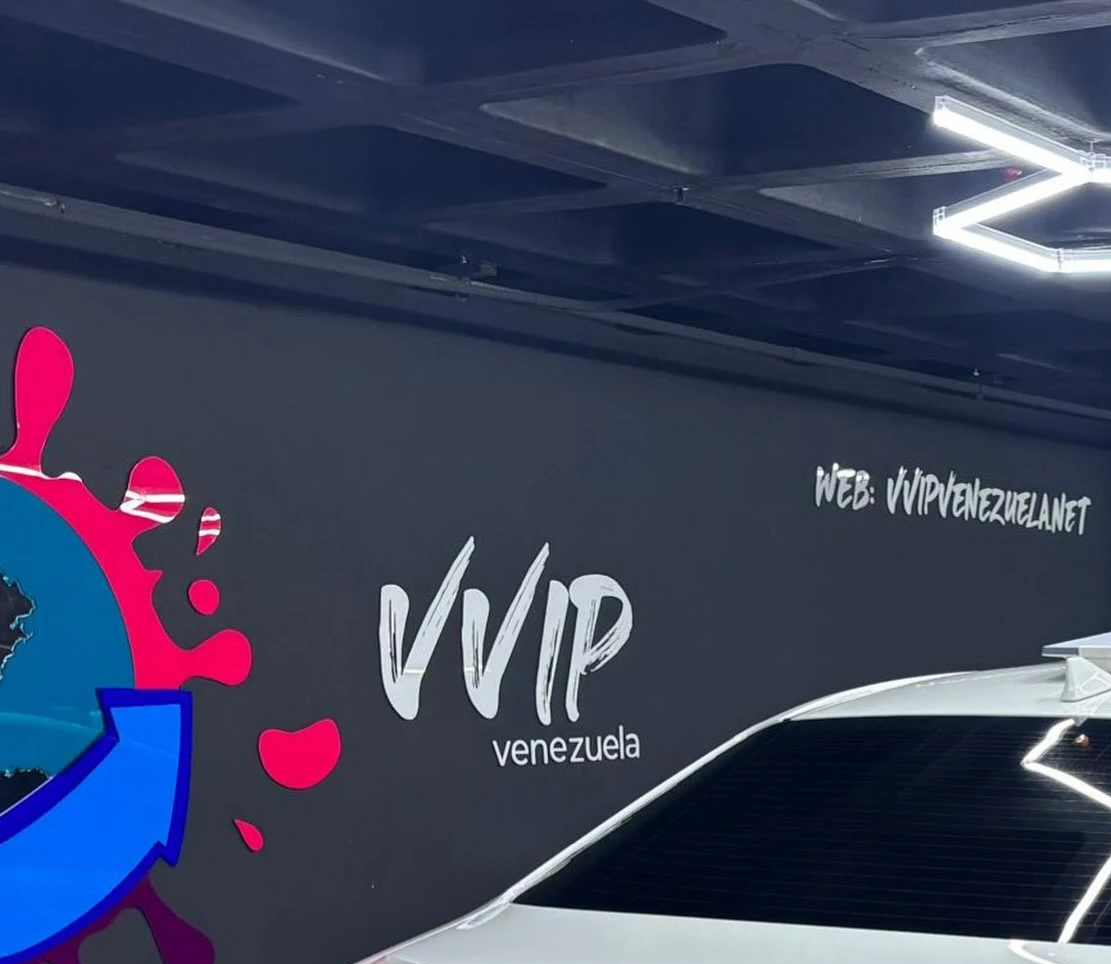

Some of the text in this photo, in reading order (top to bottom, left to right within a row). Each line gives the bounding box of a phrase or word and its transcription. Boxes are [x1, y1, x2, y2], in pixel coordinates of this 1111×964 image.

[815, 462, 875, 510] WEB:
[379, 535, 634, 727] VVIP
[492, 724, 641, 767] venezuela
